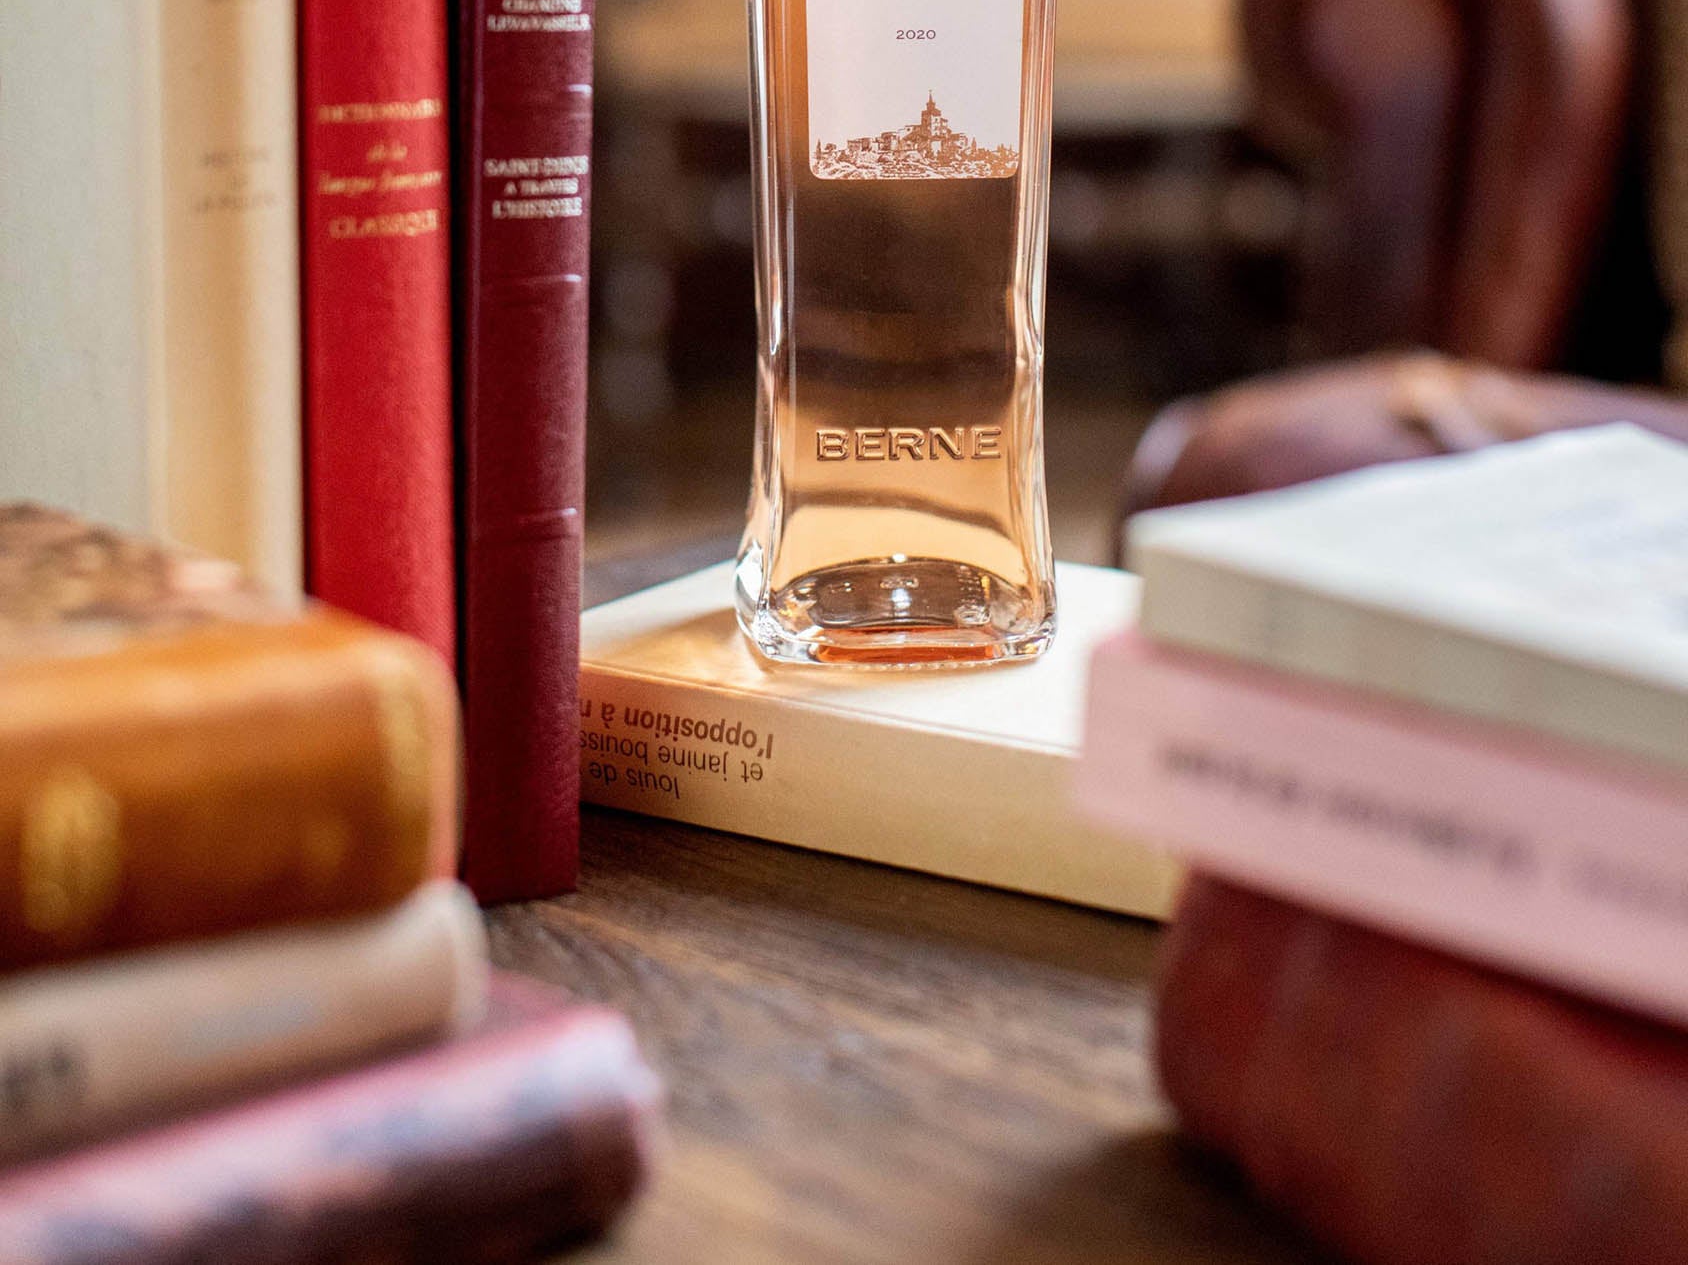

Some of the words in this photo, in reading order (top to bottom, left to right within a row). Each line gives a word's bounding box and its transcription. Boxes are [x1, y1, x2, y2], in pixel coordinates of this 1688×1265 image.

[896, 29, 937, 40] 2020
[816, 426, 1002, 461] BERNE
[601, 701, 615, 729] à
[624, 707, 773, 759] l'opposition
[589, 761, 617, 782] de
[658, 745, 729, 781] janine
[741, 760, 763, 783] et
[626, 770, 680, 799] louis
